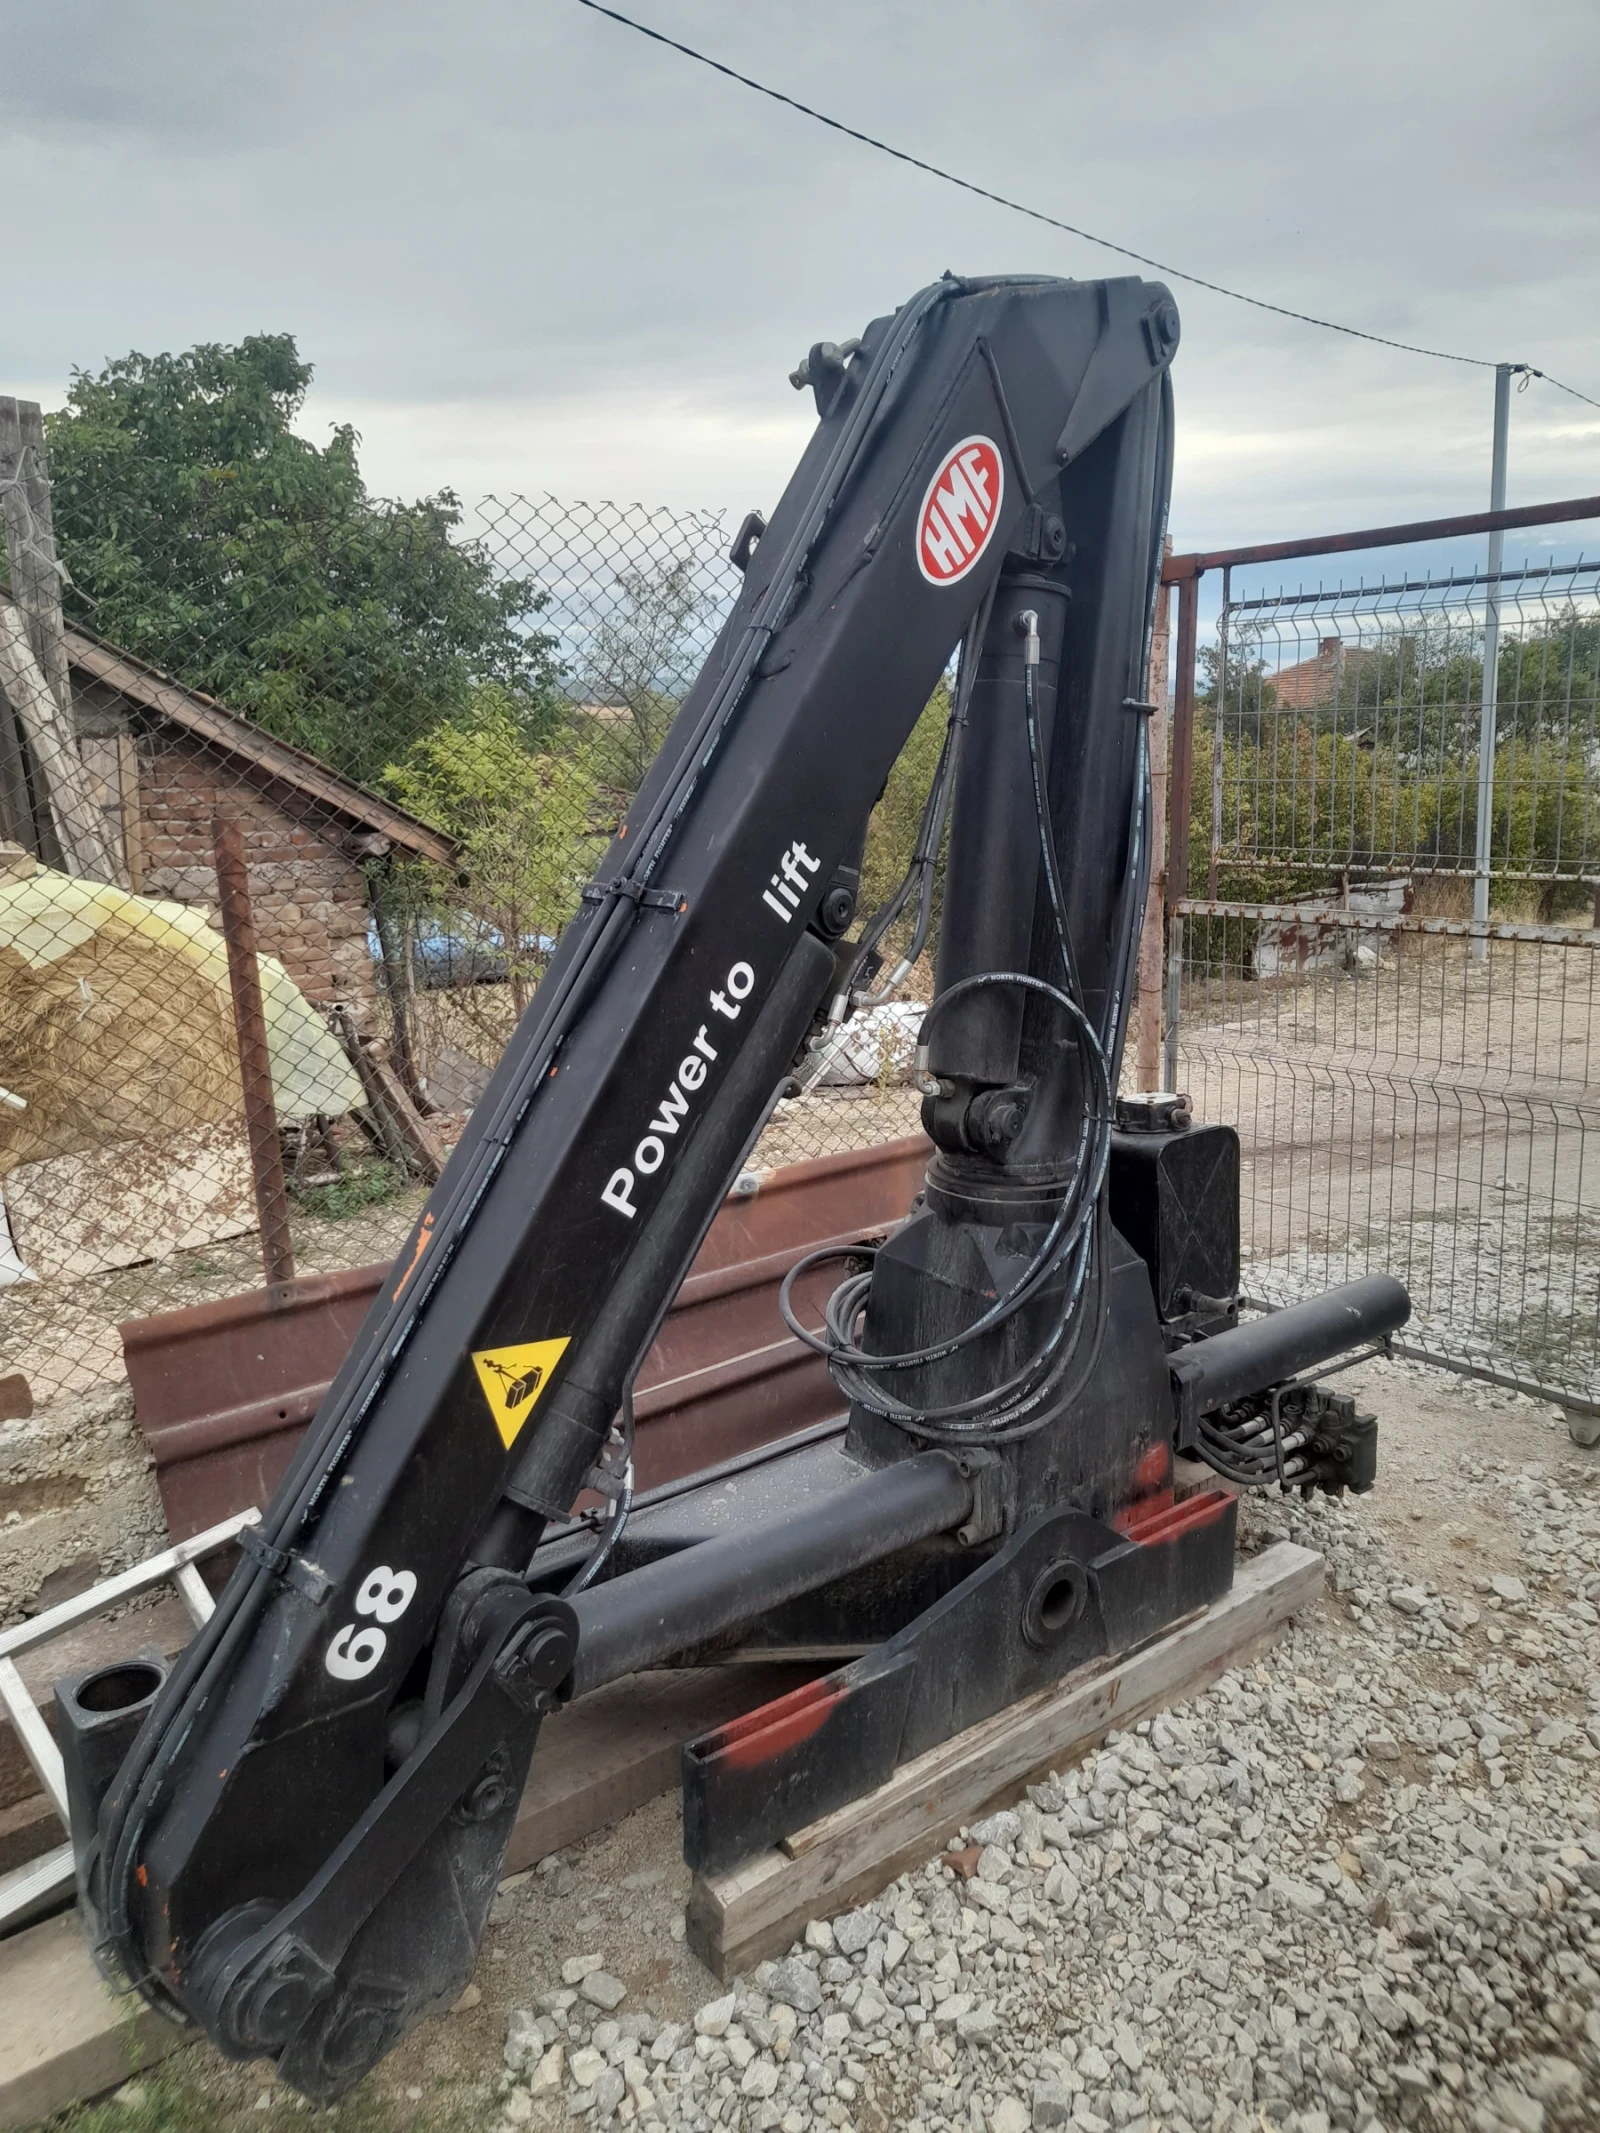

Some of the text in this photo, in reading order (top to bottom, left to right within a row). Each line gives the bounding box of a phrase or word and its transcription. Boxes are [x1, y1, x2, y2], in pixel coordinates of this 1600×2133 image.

[925, 447, 993, 574] HMF
[600, 840, 821, 1219] Power to lift
[308, 1429, 353, 1506] NORTH FIGHTER
[325, 1564, 418, 1681] 68
